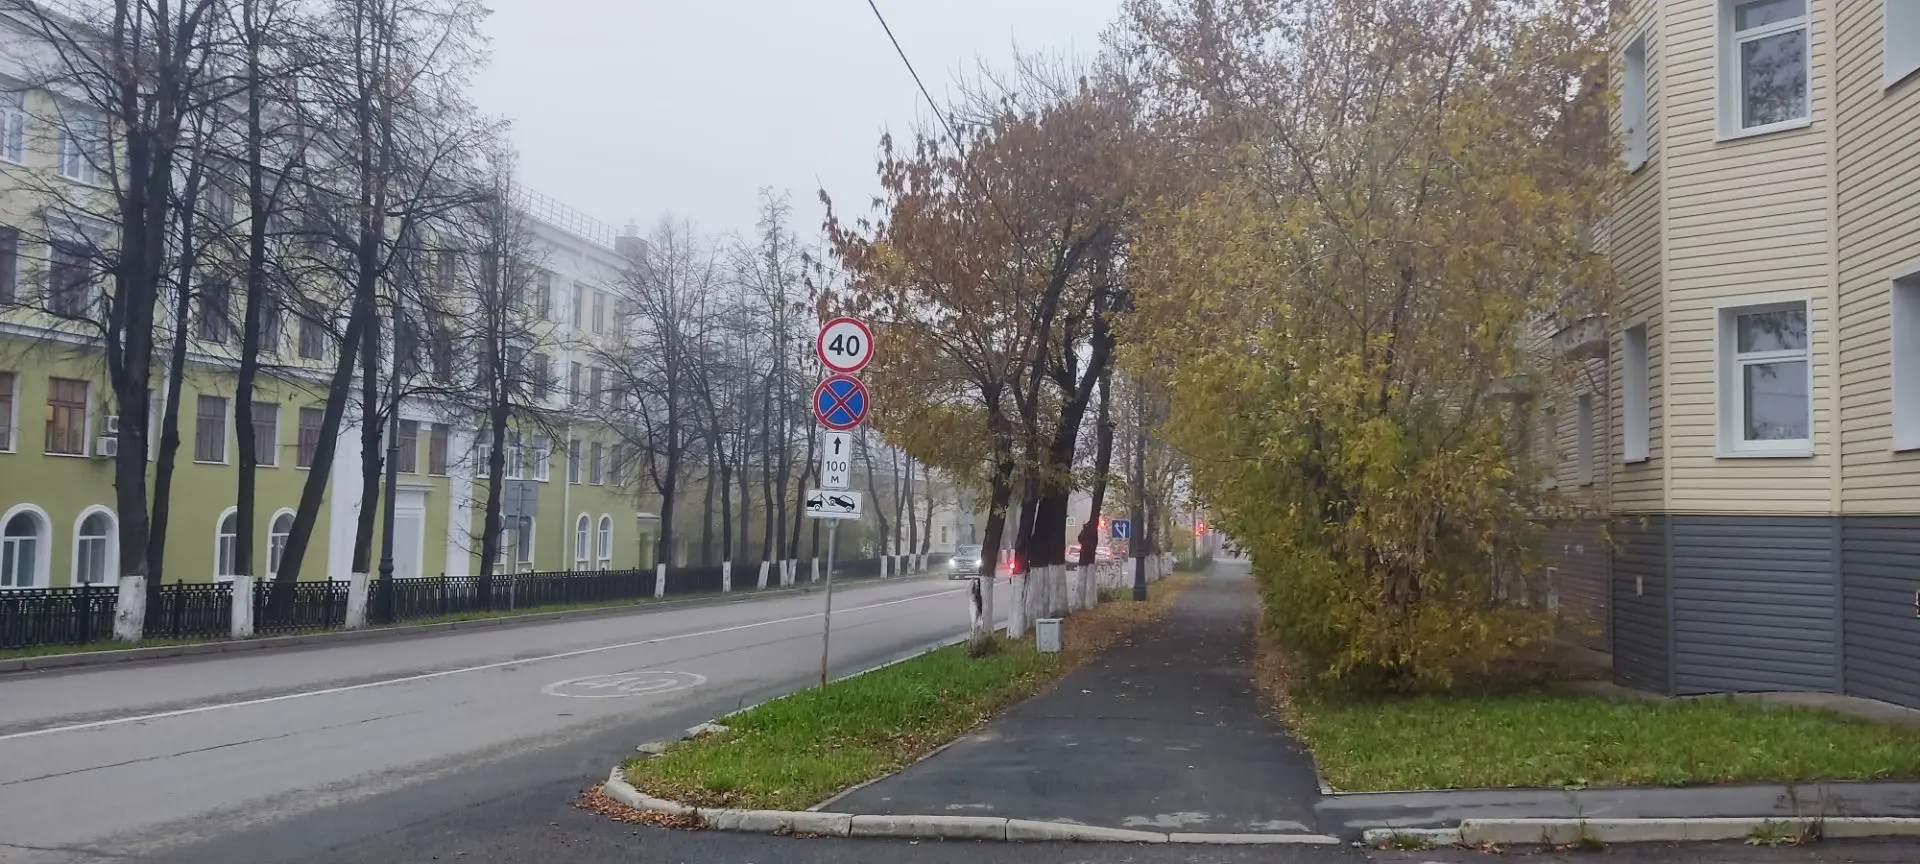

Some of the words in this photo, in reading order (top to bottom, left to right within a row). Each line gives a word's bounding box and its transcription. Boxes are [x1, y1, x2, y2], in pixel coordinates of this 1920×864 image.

[828, 333, 860, 356] 40
[826, 461, 847, 472] 100
[571, 677, 678, 691] 40
